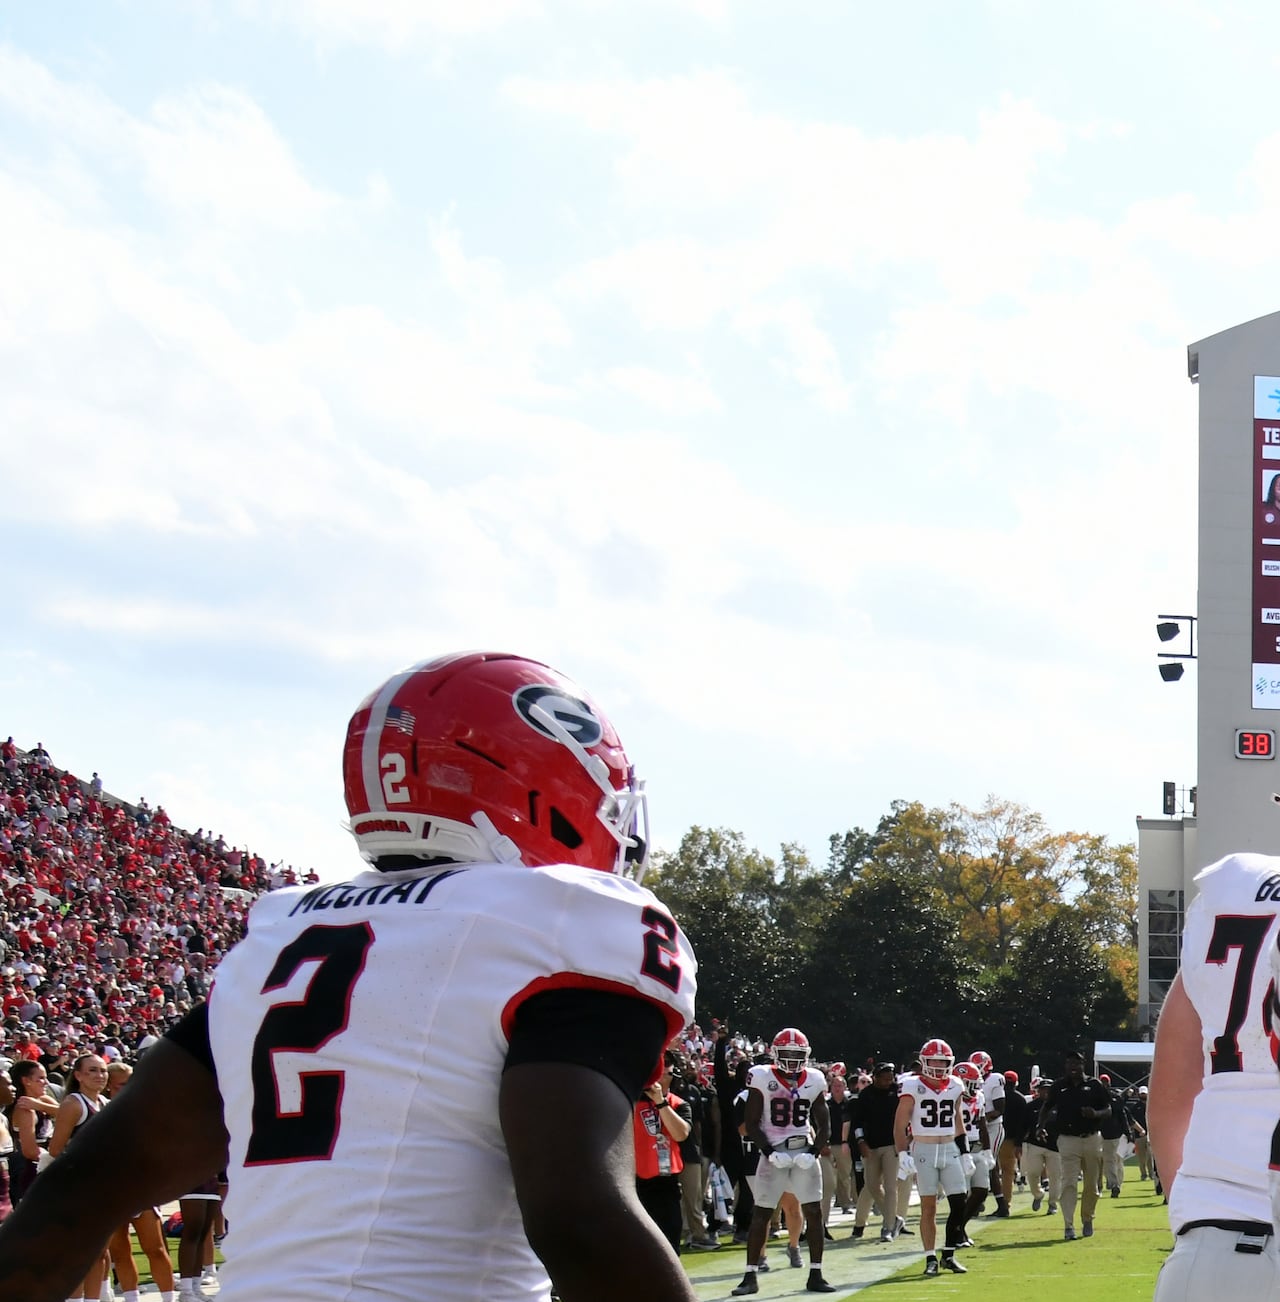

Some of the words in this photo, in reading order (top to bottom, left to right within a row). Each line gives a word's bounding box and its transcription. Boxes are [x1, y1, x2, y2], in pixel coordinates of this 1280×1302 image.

[1242, 734, 1269, 754] 38
[381, 753, 411, 804] 2
[640, 905, 686, 993] 2
[243, 921, 375, 1167] 2
[770, 1097, 810, 1127] 86
[920, 1099, 954, 1128] 32
